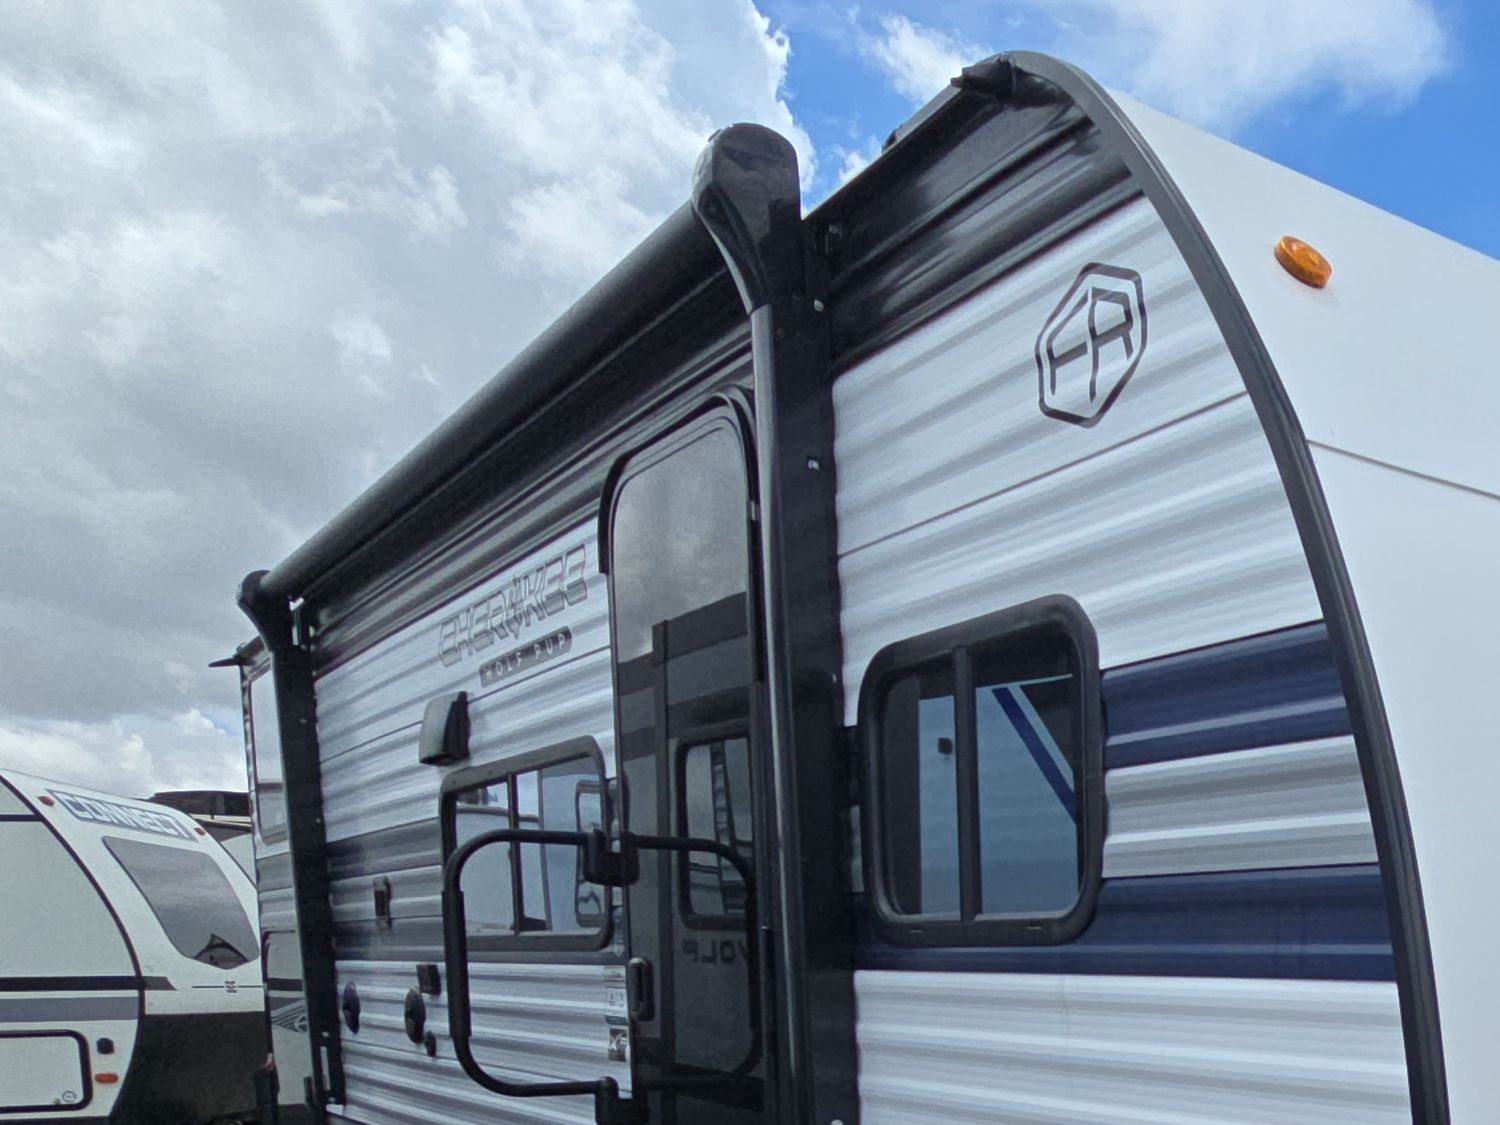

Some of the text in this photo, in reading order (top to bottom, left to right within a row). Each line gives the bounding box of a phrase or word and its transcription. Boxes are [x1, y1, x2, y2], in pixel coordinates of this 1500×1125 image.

[484, 630, 567, 680] WOLF PUP
[47, 789, 198, 842] CONNECT
